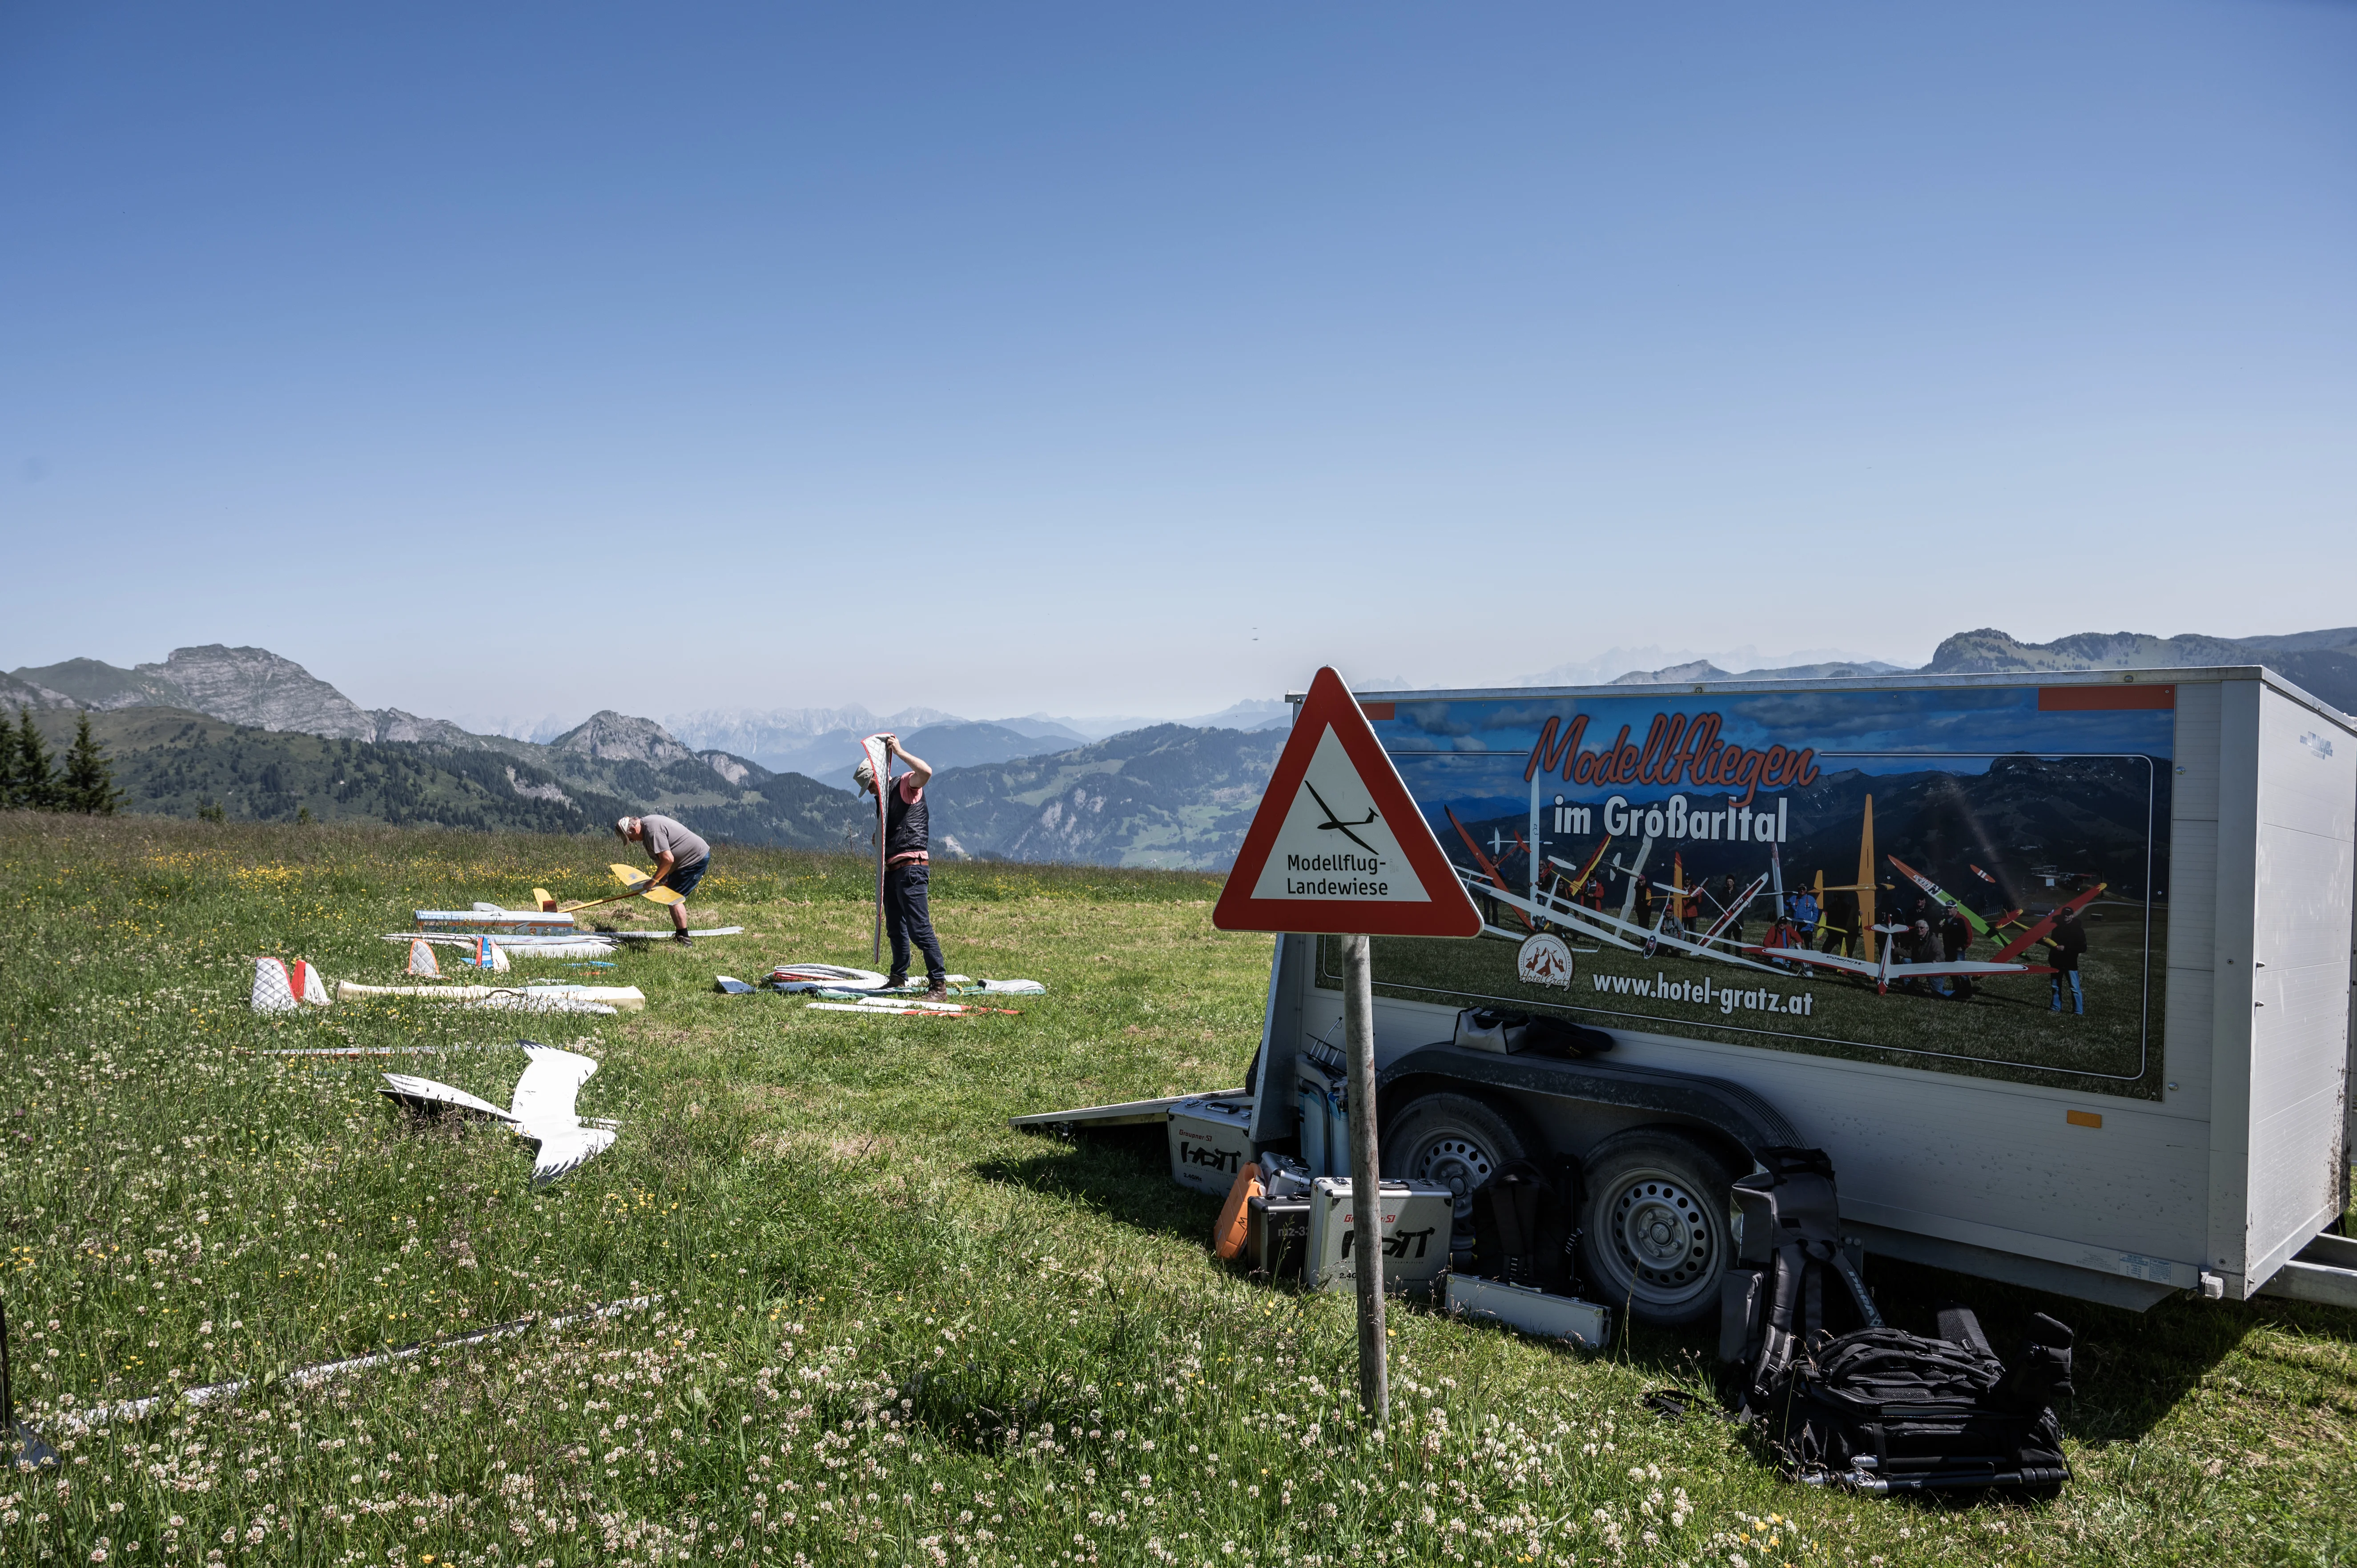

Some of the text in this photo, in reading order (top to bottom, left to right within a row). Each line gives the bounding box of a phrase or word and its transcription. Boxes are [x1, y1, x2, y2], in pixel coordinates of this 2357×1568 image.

[1525, 712, 1818, 807] Modellfliegen
[1555, 795, 1787, 843] im Großarltal
[1287, 854, 1386, 875] Modellflug-
[1287, 877, 1388, 895] Landewiese
[1520, 969, 1570, 991] Hotel Gratz
[1593, 972, 1813, 1015] www.hotel-gratz.at
[1183, 1172, 1203, 1182] 2.4GHz
